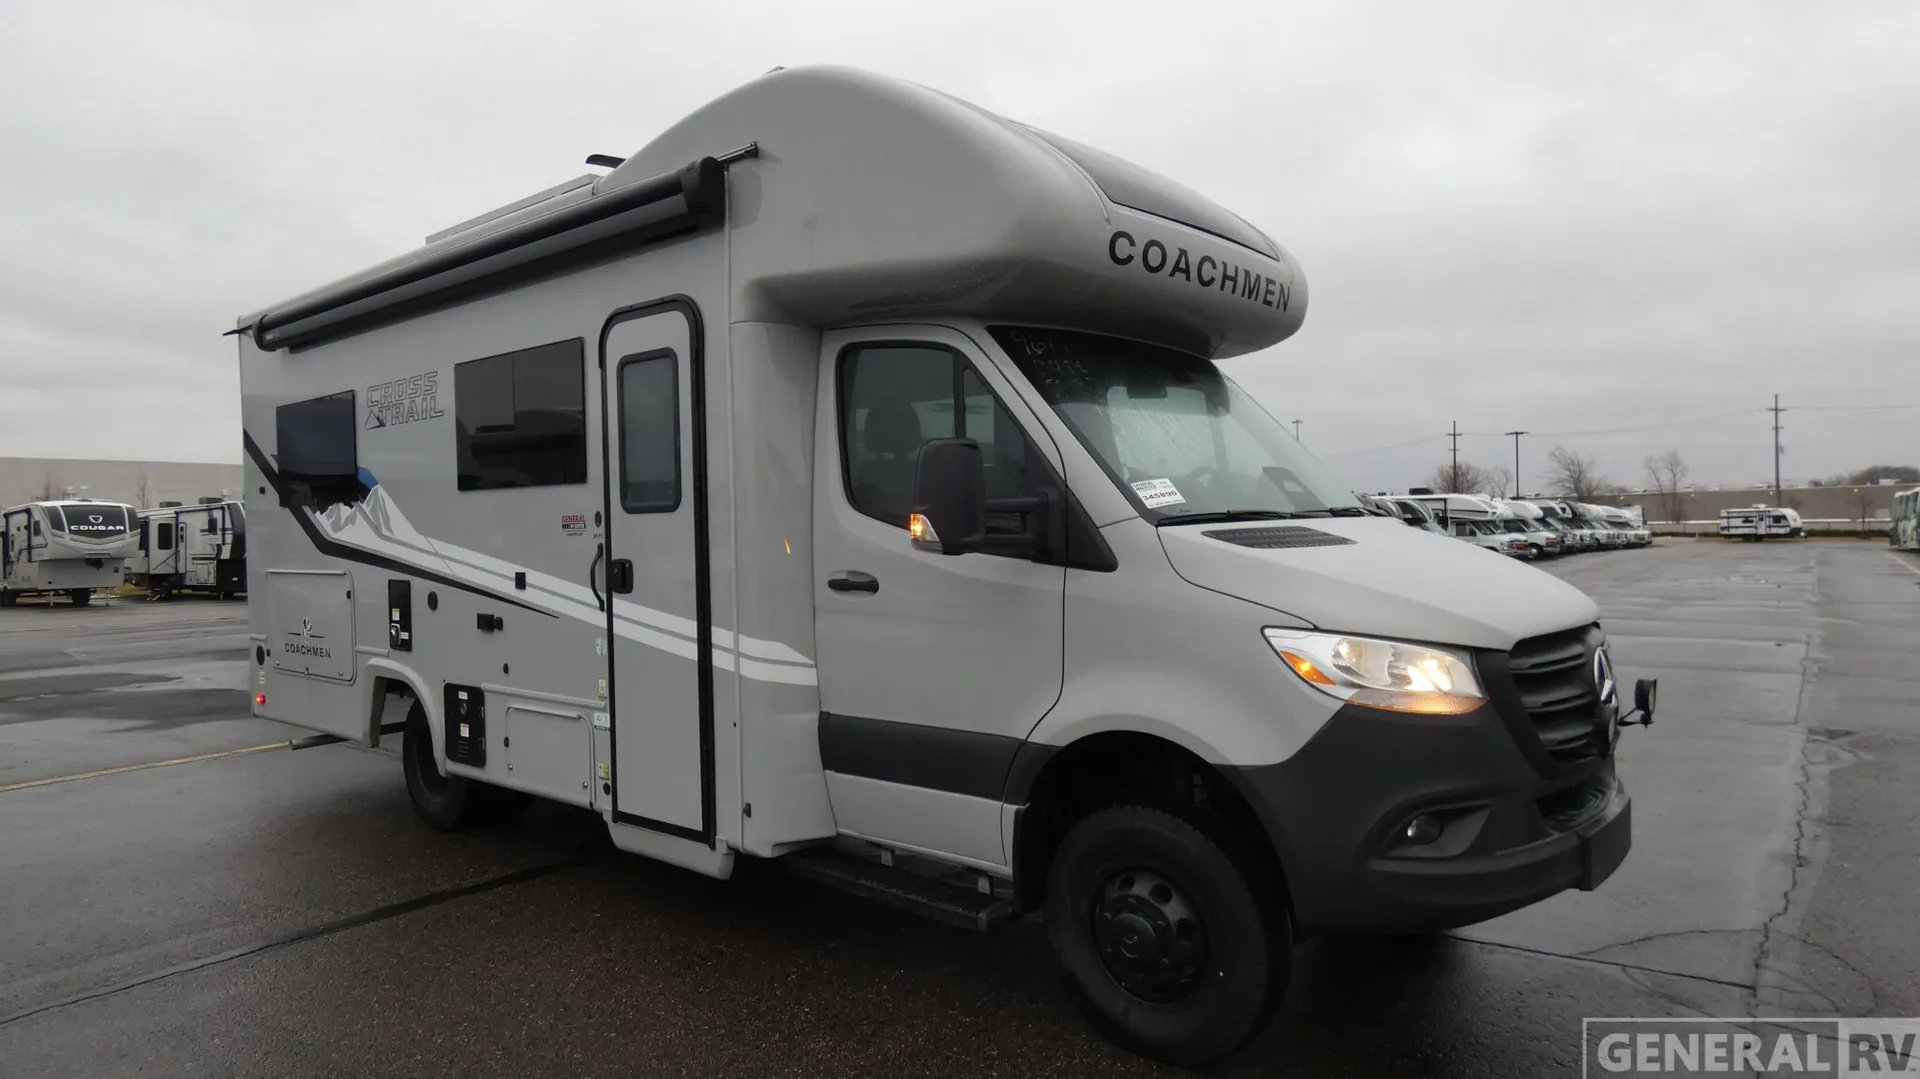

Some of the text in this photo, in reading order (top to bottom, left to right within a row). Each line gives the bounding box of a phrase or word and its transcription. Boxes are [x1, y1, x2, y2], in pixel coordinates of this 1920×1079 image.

[1108, 230, 1291, 313] COACHMEN
[366, 370, 438, 408] CROSS
[378, 395, 444, 426] TRAIL
[1141, 490, 1178, 501] 345890
[561, 514, 585, 523] GENERAL
[284, 642, 332, 659] COACHMEN
